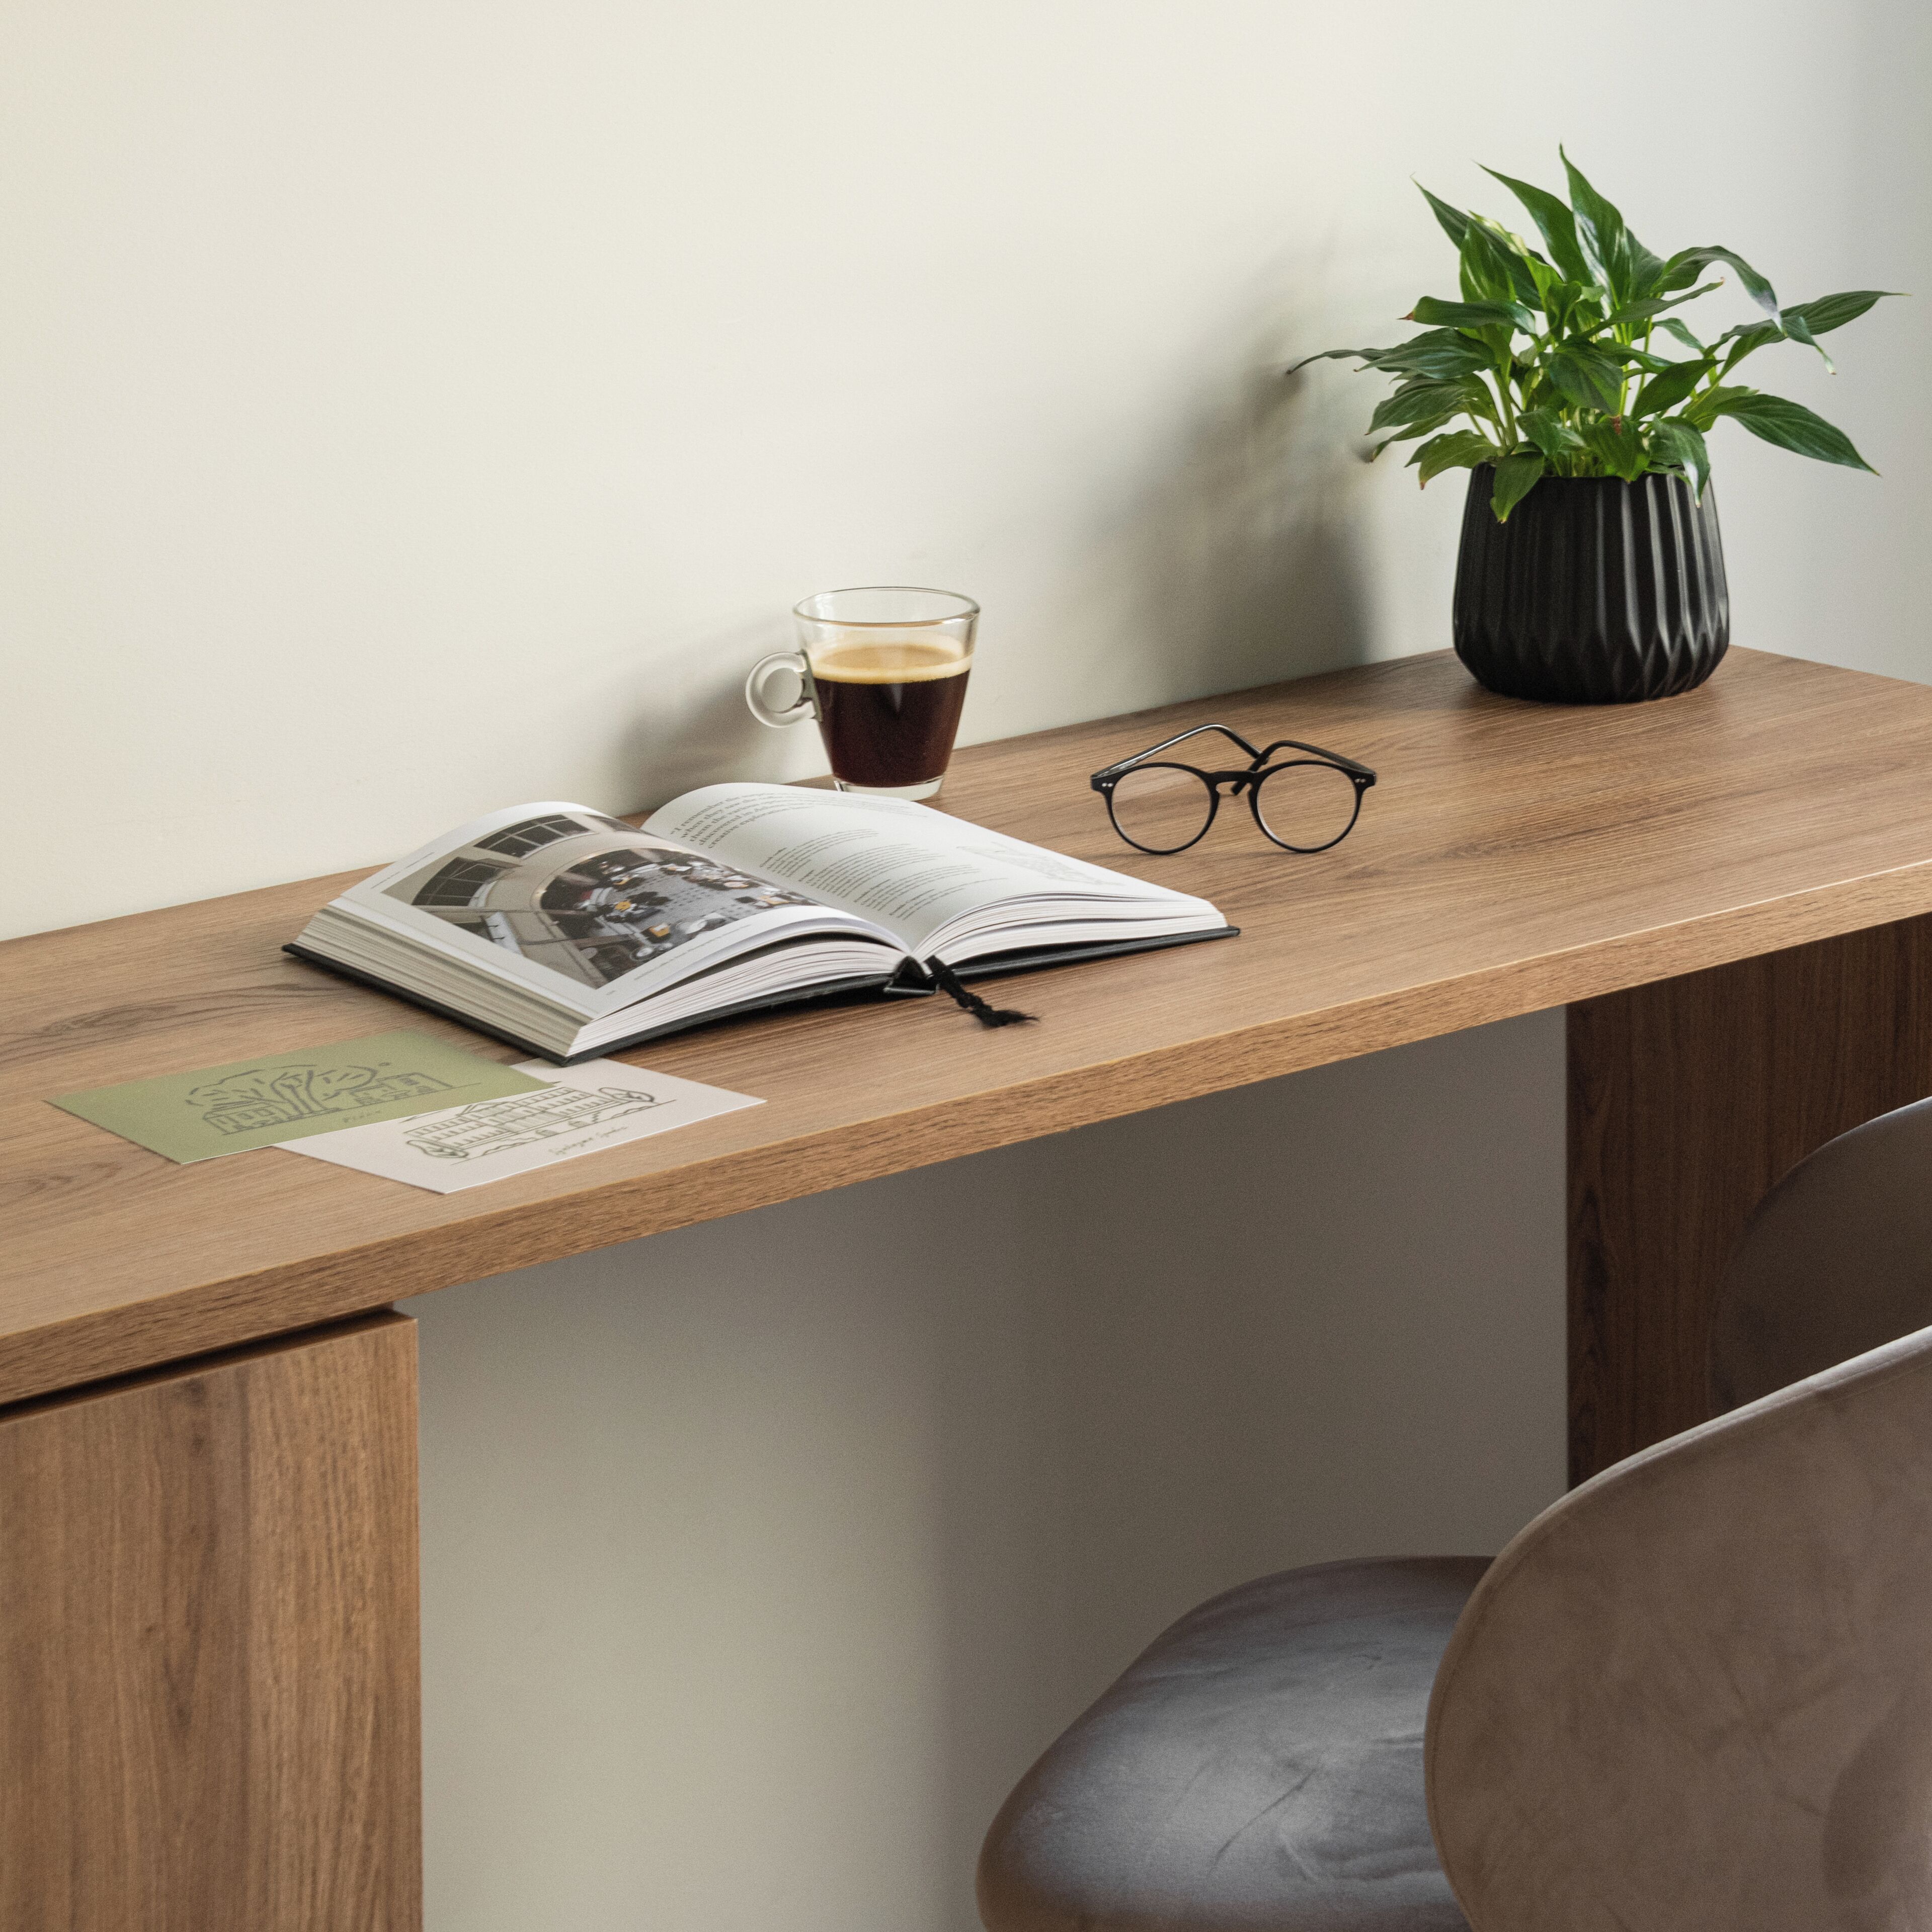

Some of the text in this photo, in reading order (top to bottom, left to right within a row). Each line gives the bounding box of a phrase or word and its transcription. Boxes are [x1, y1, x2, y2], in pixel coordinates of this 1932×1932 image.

[680, 820, 704, 838] when
[703, 809, 722, 820] they
[681, 801, 723, 826] remember
[690, 825, 712, 841] them
[711, 815, 727, 823] the
[699, 815, 742, 845] discovered
[708, 825, 739, 848] creative
